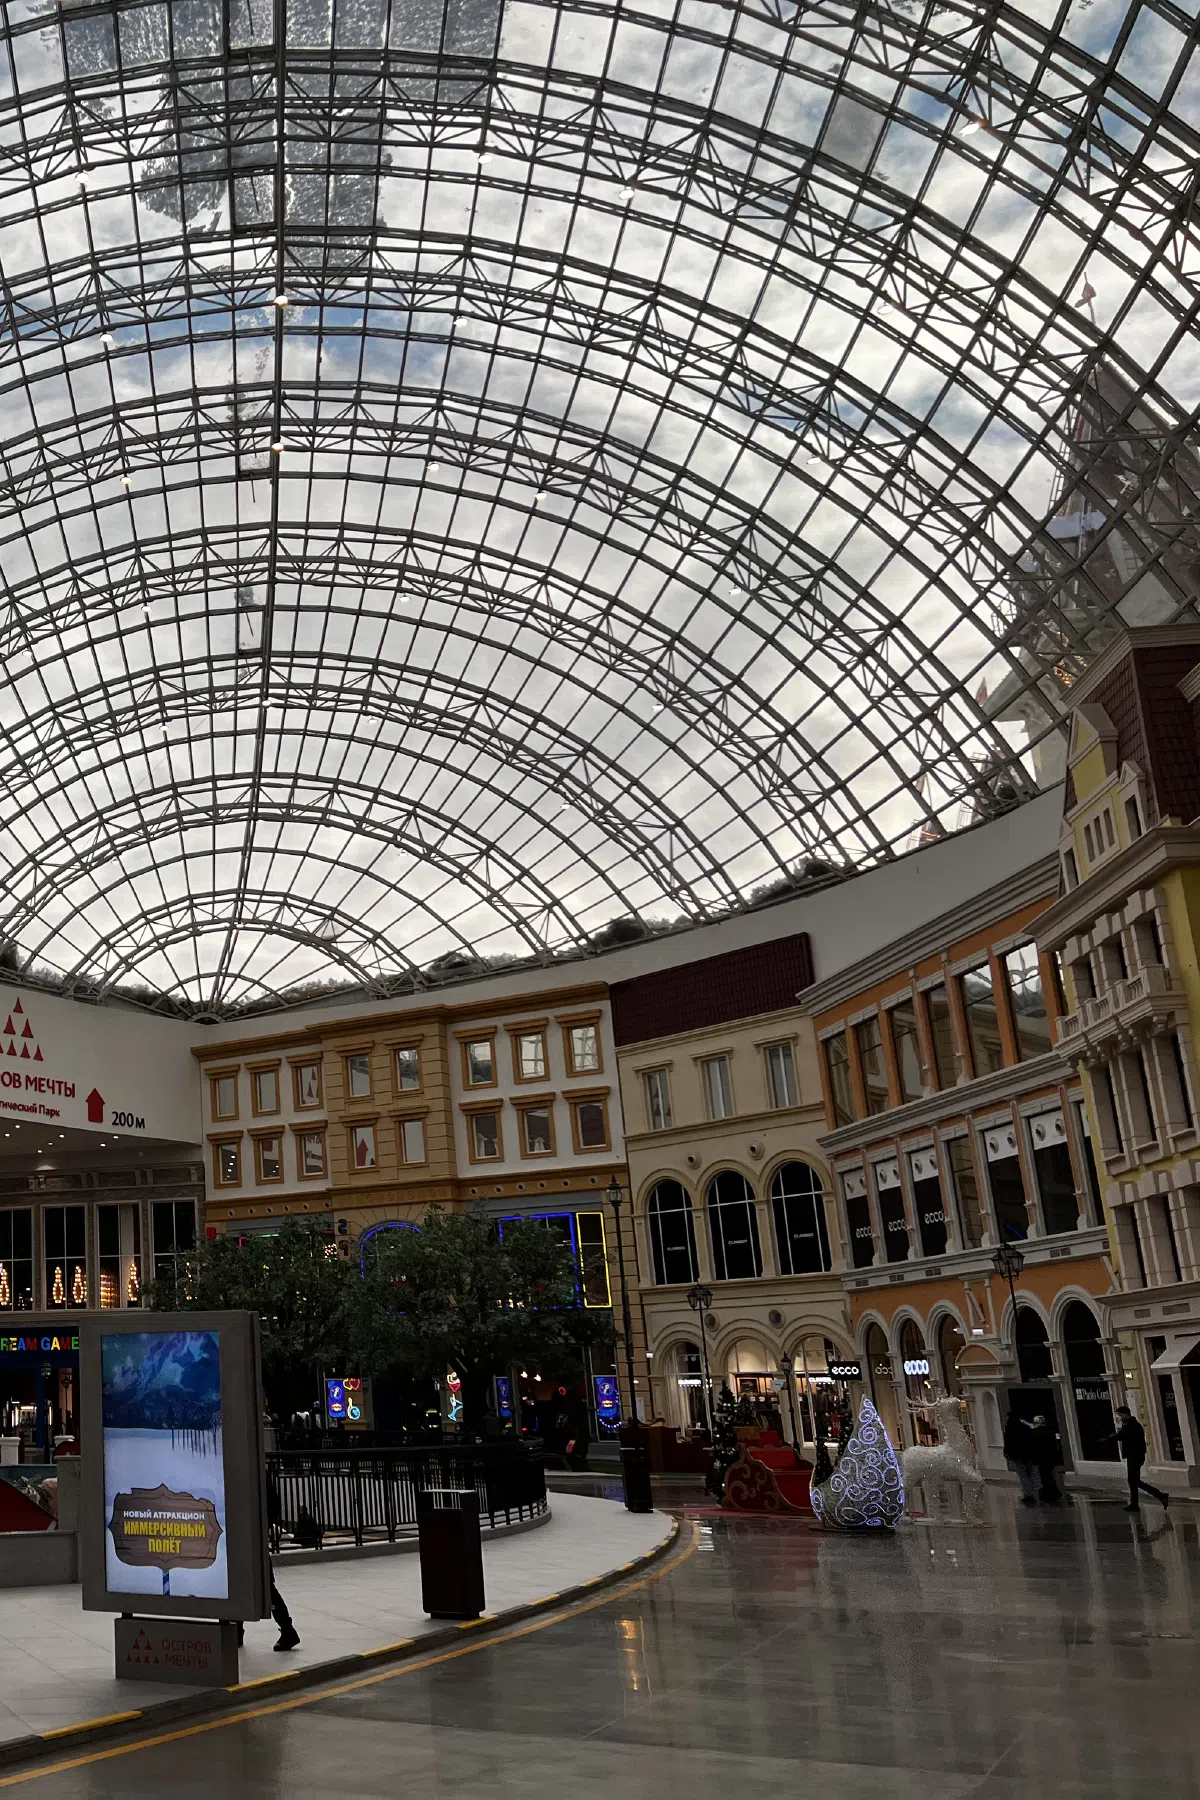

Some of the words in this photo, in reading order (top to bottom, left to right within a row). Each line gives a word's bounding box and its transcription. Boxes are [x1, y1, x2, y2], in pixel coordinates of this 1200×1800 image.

[25, 1074, 76, 1099] МЕЧТЫ
[38, 1104, 61, 1119] Парк
[831, 1366, 860, 1375] ecco
[123, 1509, 152, 1519] НОВЫЙ
[153, 1511, 205, 1520] АТТРАКЦИОН
[123, 1521, 206, 1537] ИММЕРСИВНЫЙ
[148, 1538, 181, 1553] ПОЛЁТ
[161, 1638, 211, 1653] ОСТРОВ
[164, 1653, 209, 1668] МЕЧТЫ
